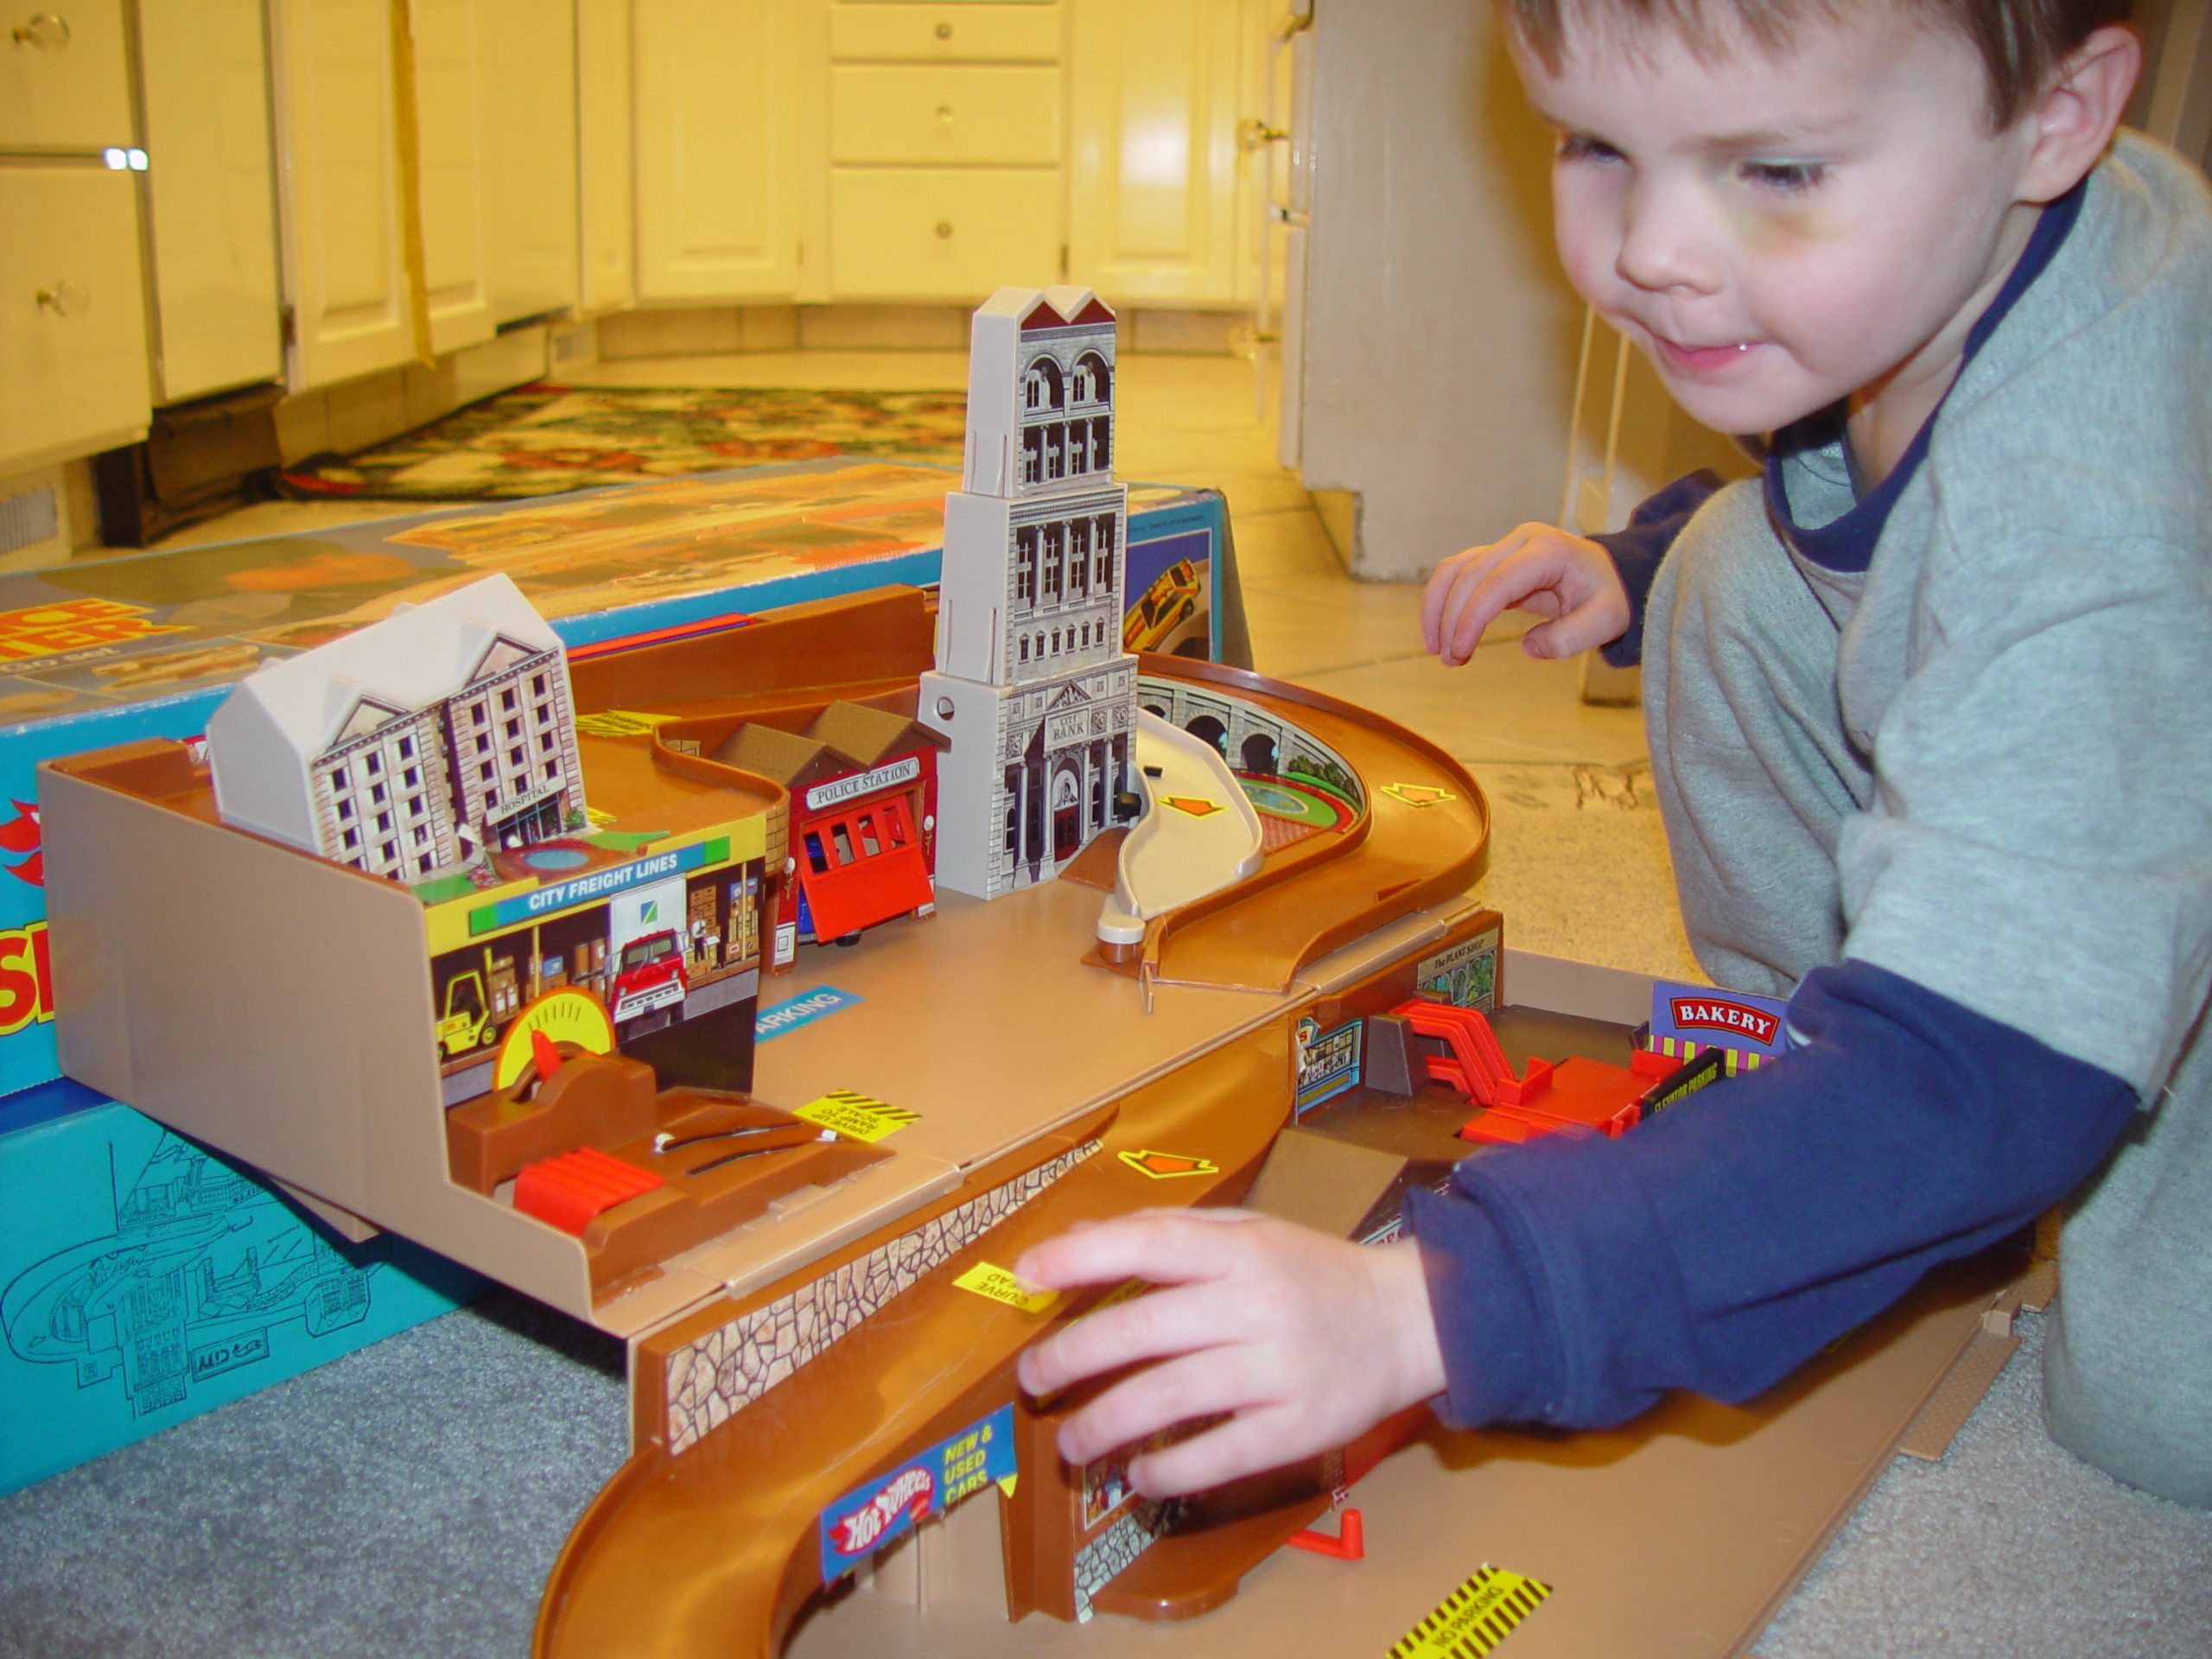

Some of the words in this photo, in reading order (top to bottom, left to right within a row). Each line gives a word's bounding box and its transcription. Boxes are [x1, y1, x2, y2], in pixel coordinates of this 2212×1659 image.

[1053, 722, 1084, 741] BANK
[816, 780, 860, 804] POLICE
[862, 762, 912, 789] STATION
[501, 785, 550, 815] HOSPITAL
[529, 885, 567, 911] CITY
[569, 866, 633, 899] FREIGHT
[636, 854, 678, 879] LINES
[1434, 959, 1445, 969] The
[1446, 947, 1466, 964] PLANT
[1466, 938, 1484, 955] SHOP
[755, 993, 842, 1034] ARKING
[1679, 1005, 1771, 1035] BAKERY
[810, 1113, 830, 1122] UP
[821, 1109, 839, 1117] TO
[830, 1121, 870, 1135] DRIVE
[836, 1106, 880, 1123] SCALE
[840, 1116, 878, 1130] RAMP
[974, 1281, 1029, 1306] CURVE
[944, 1431, 979, 1465] NEW
[981, 1423, 993, 1444] &
[944, 1448, 987, 1485] USED
[944, 1469, 988, 1505] CARS
[1432, 1630, 1458, 1649] NO
[1451, 1586, 1503, 1631] PARKING
